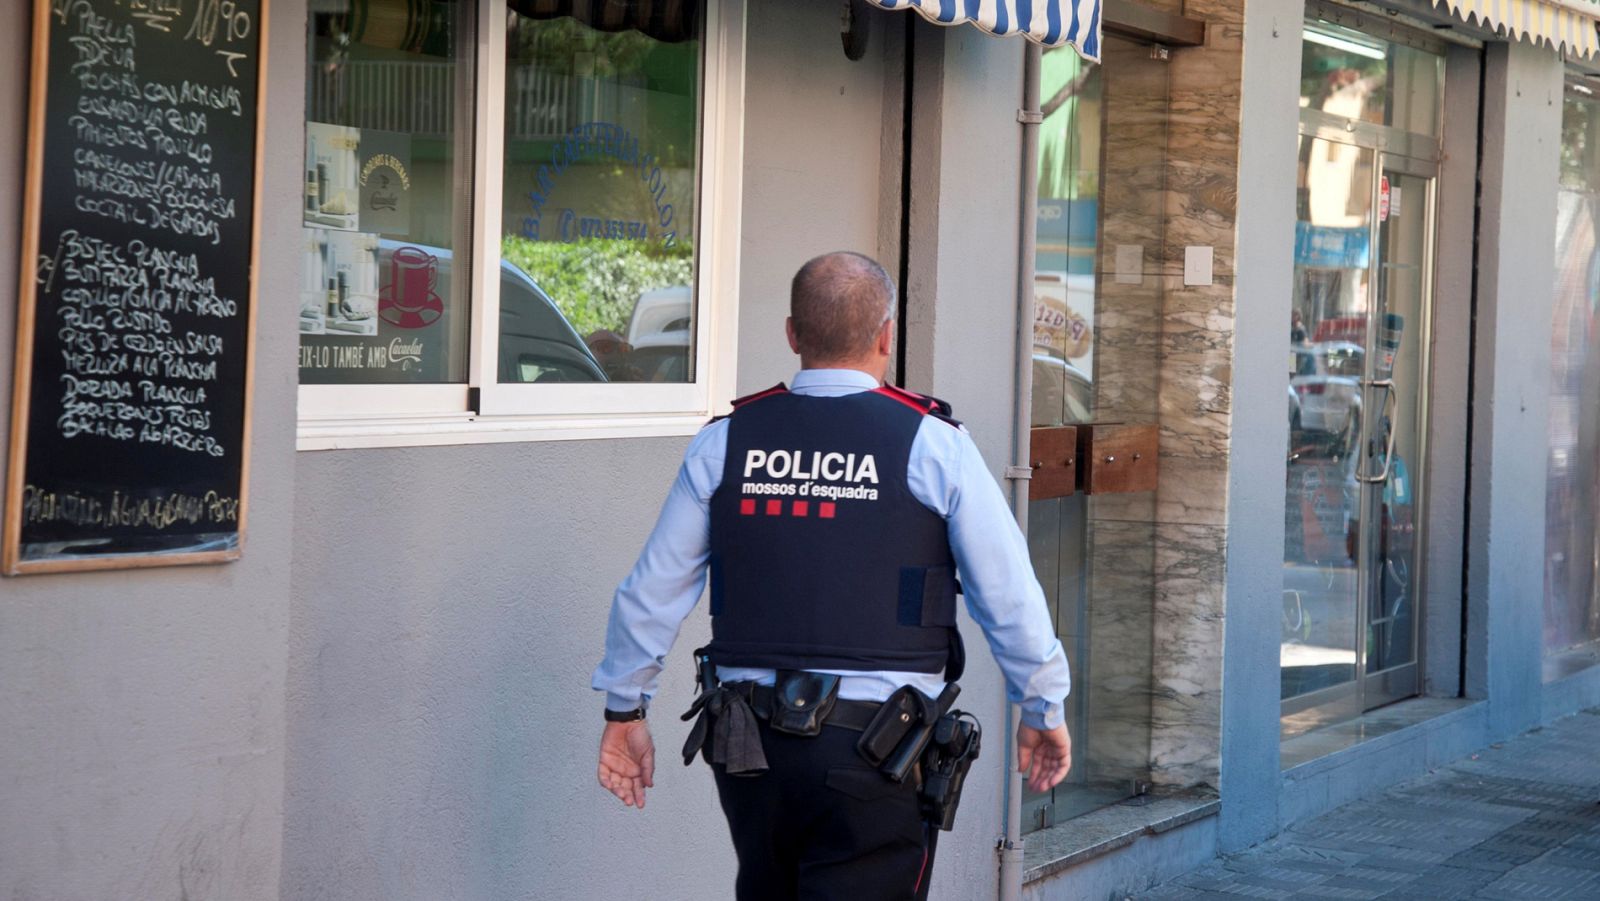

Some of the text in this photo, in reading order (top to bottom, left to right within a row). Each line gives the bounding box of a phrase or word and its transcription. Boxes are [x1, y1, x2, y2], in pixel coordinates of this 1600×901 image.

[71, 0, 136, 48] PAELLA
[144, 82, 177, 106] CON
[60, 229, 199, 281] BISTEC PLANCHA
[98, 331, 120, 352] DE
[186, 331, 224, 356] SALSA
[333, 342, 364, 369] TAMBÉ
[367, 346, 387, 369] AMB
[60, 373, 207, 405] DORADA PLANCHA
[743, 449, 879, 484] POLICIA
[742, 481, 796, 496] mossos
